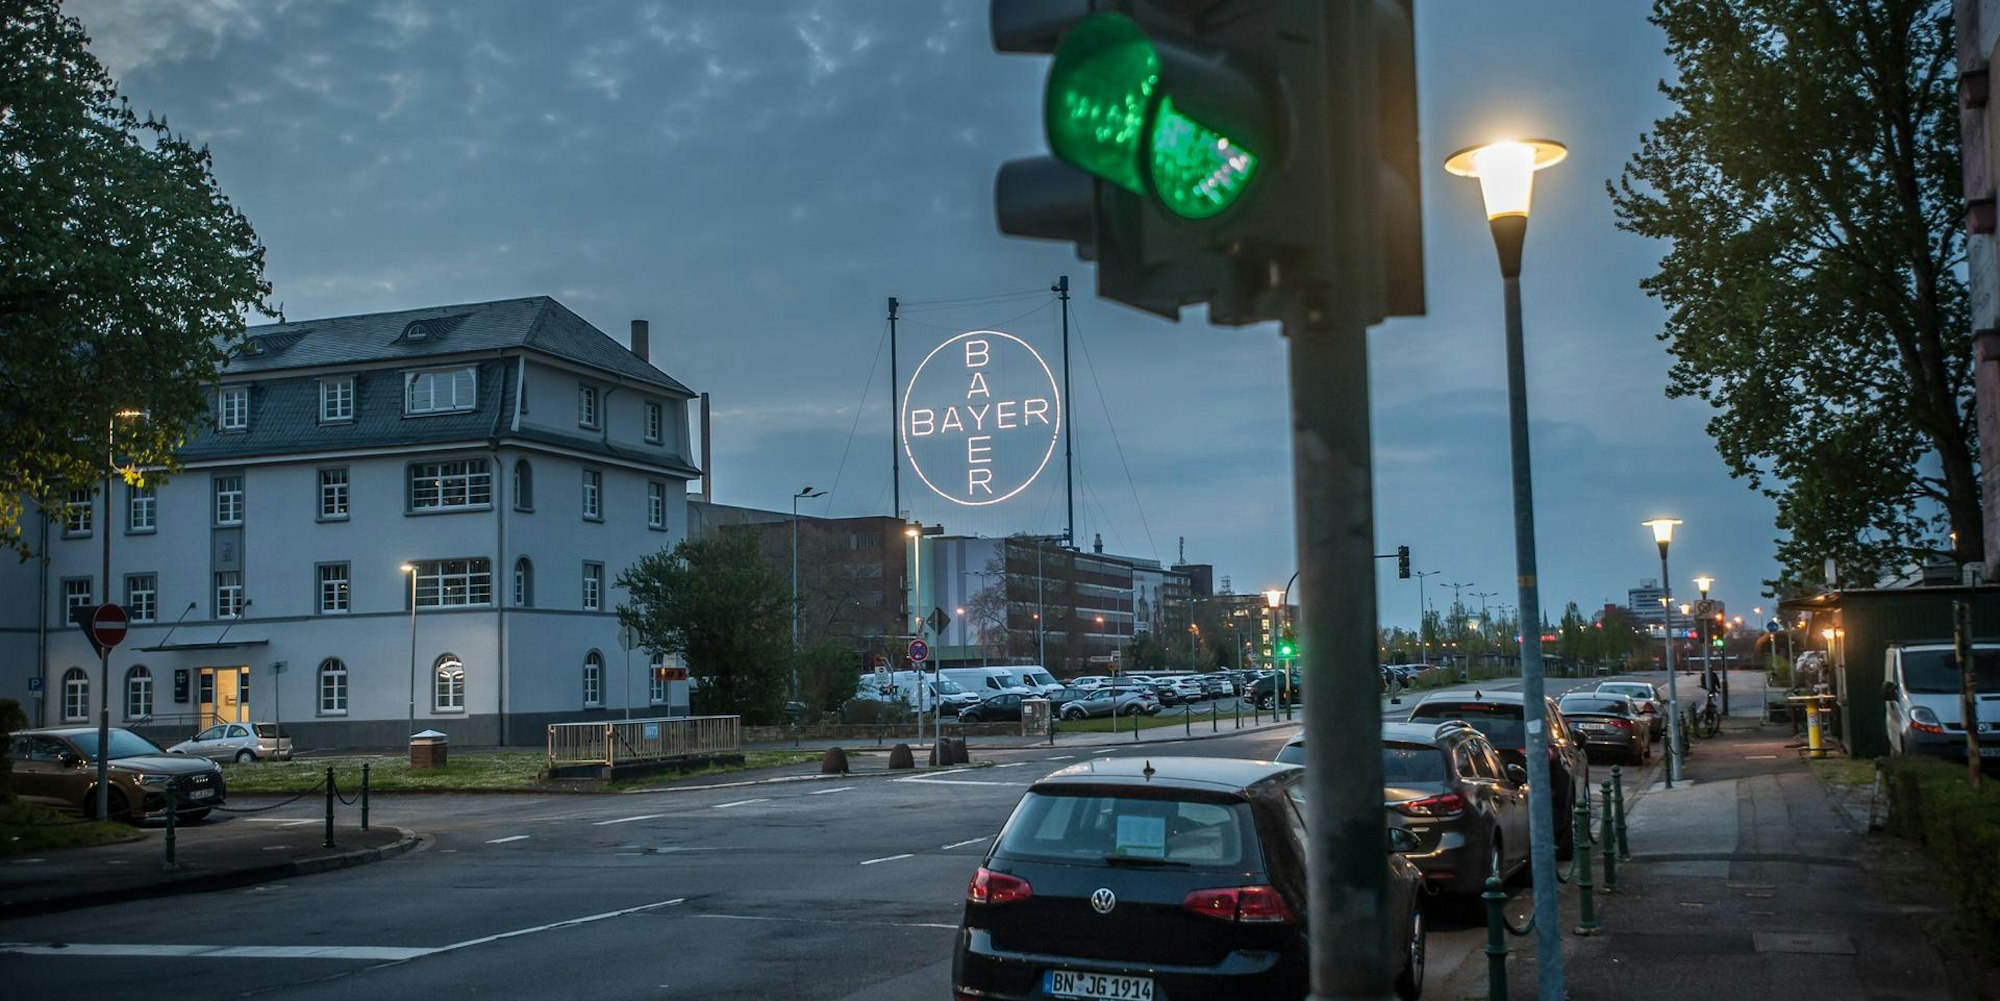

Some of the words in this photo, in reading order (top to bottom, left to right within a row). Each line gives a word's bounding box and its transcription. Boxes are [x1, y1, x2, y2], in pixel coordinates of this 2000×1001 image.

[911, 398, 1049, 436] BAYER
[966, 339, 993, 495] BAYER
[1053, 973, 1075, 992] BN
[1086, 976, 1107, 996] JG
[1110, 978, 1151, 1000] 1914
